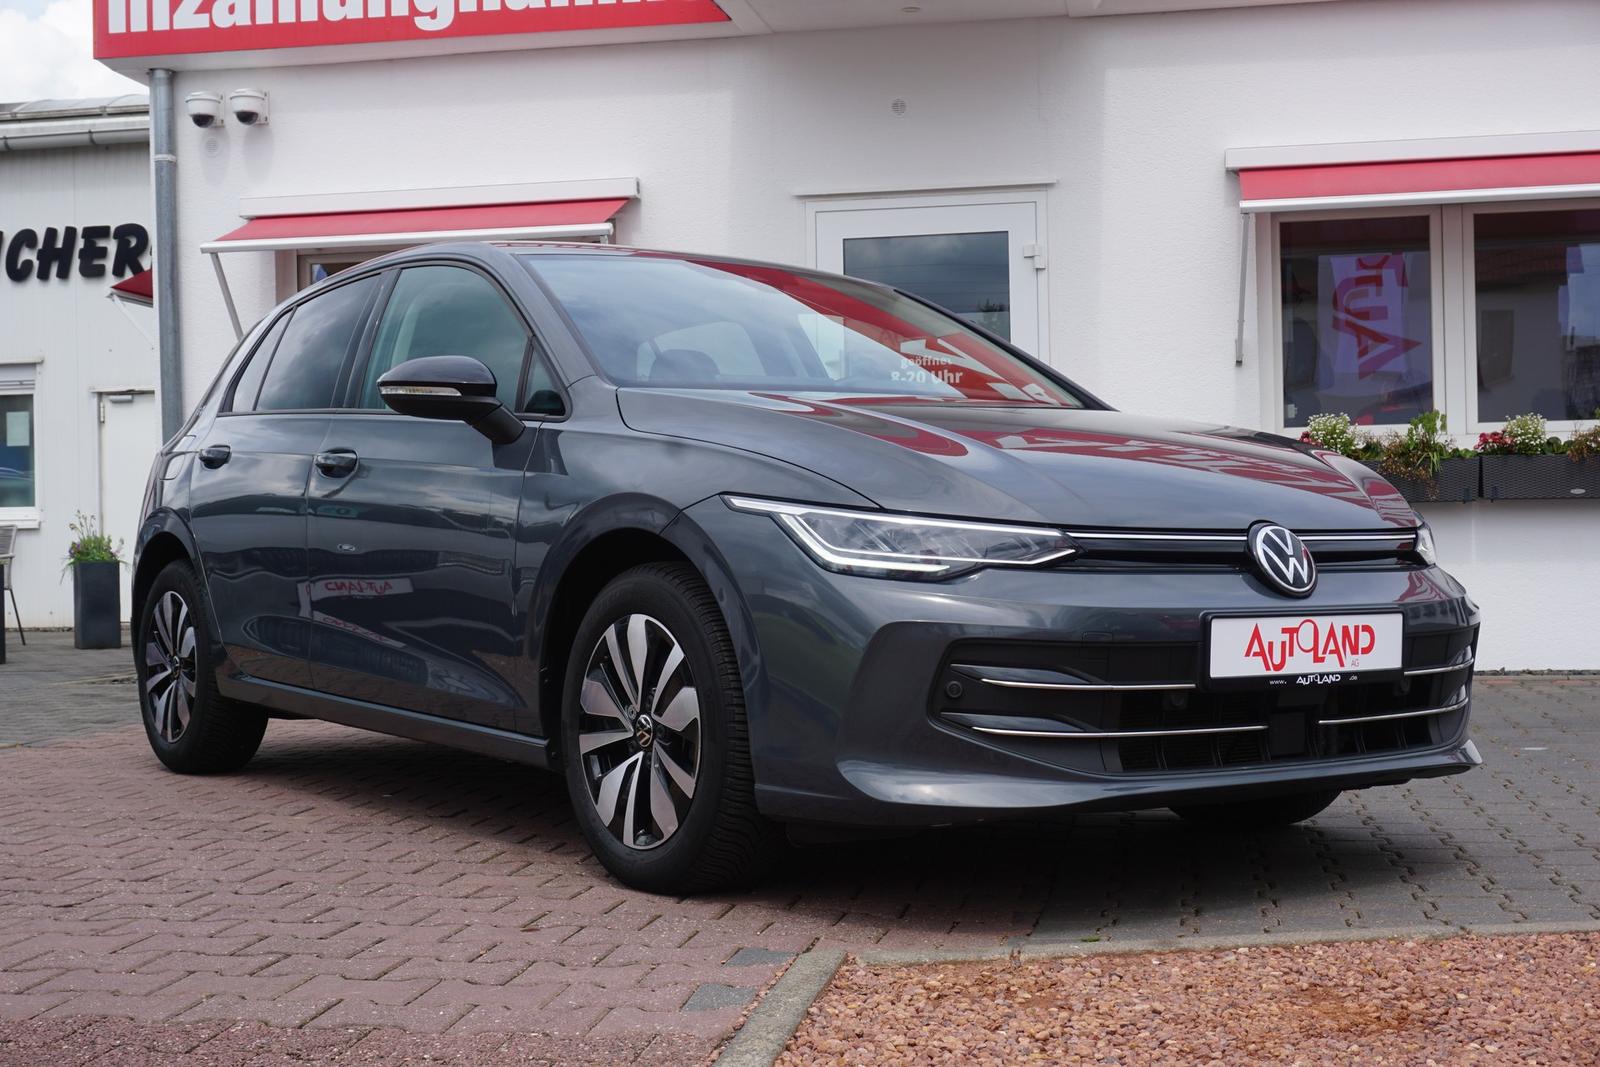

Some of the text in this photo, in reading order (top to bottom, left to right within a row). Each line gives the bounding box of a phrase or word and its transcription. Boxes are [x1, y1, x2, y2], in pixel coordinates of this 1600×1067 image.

[0, 223, 153, 282] CHER
[930, 369, 963, 383] Uhr
[1244, 618, 1376, 672] AUTOLAND
[1350, 658, 1360, 668] AG
